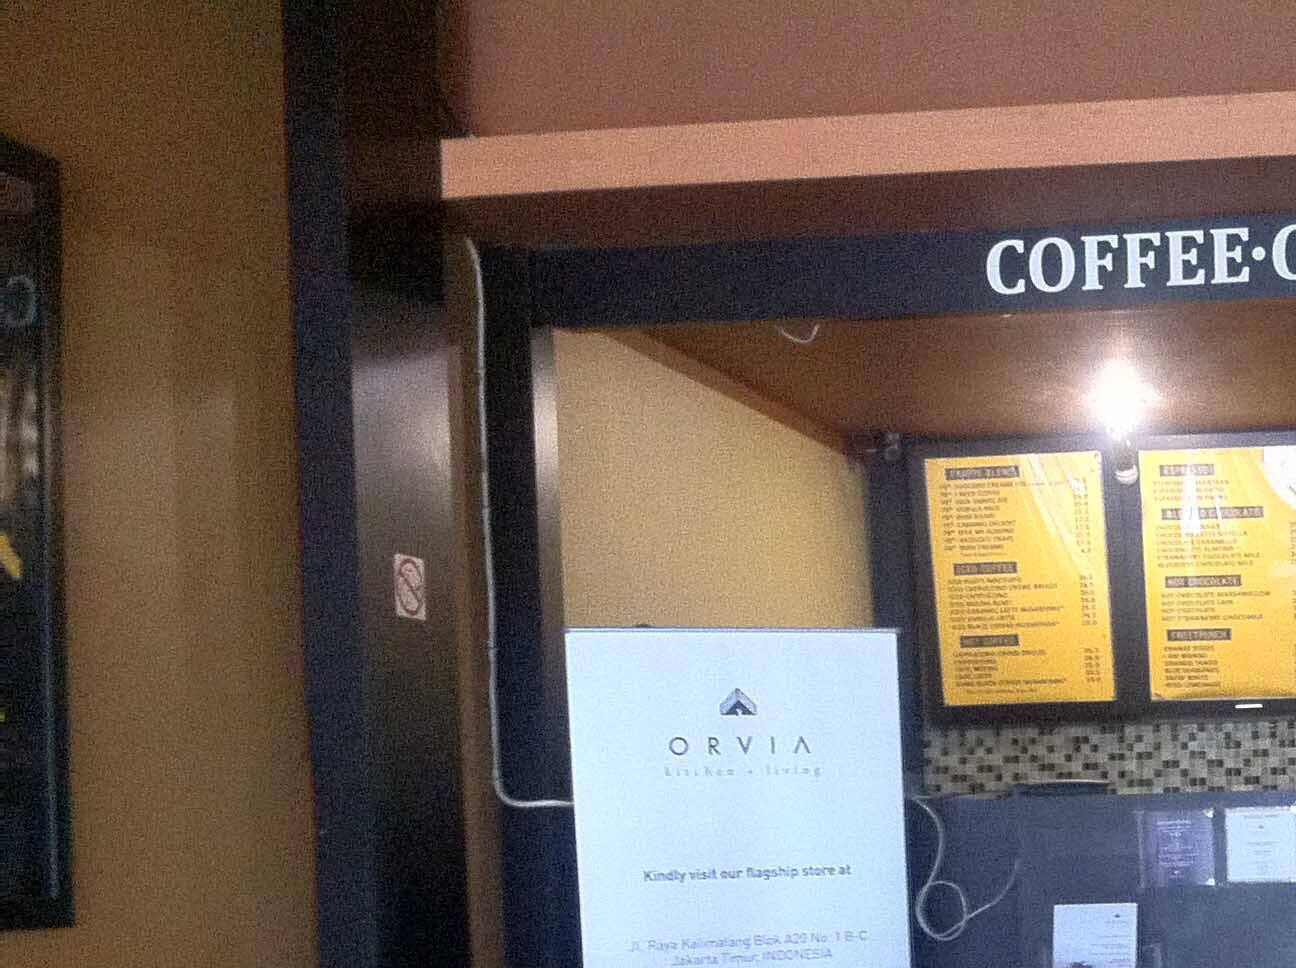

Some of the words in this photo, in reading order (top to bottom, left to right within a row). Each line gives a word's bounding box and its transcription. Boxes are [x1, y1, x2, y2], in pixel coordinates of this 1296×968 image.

[668, 736, 812, 756] ORVIA
[643, 870, 686, 884] Kindly
[689, 869, 717, 880] visit
[720, 870, 743, 880] our
[746, 866, 799, 880] flagship
[802, 865, 836, 876] store
[839, 865, 852, 876] at
[762, 949, 833, 961] INDONESIA
